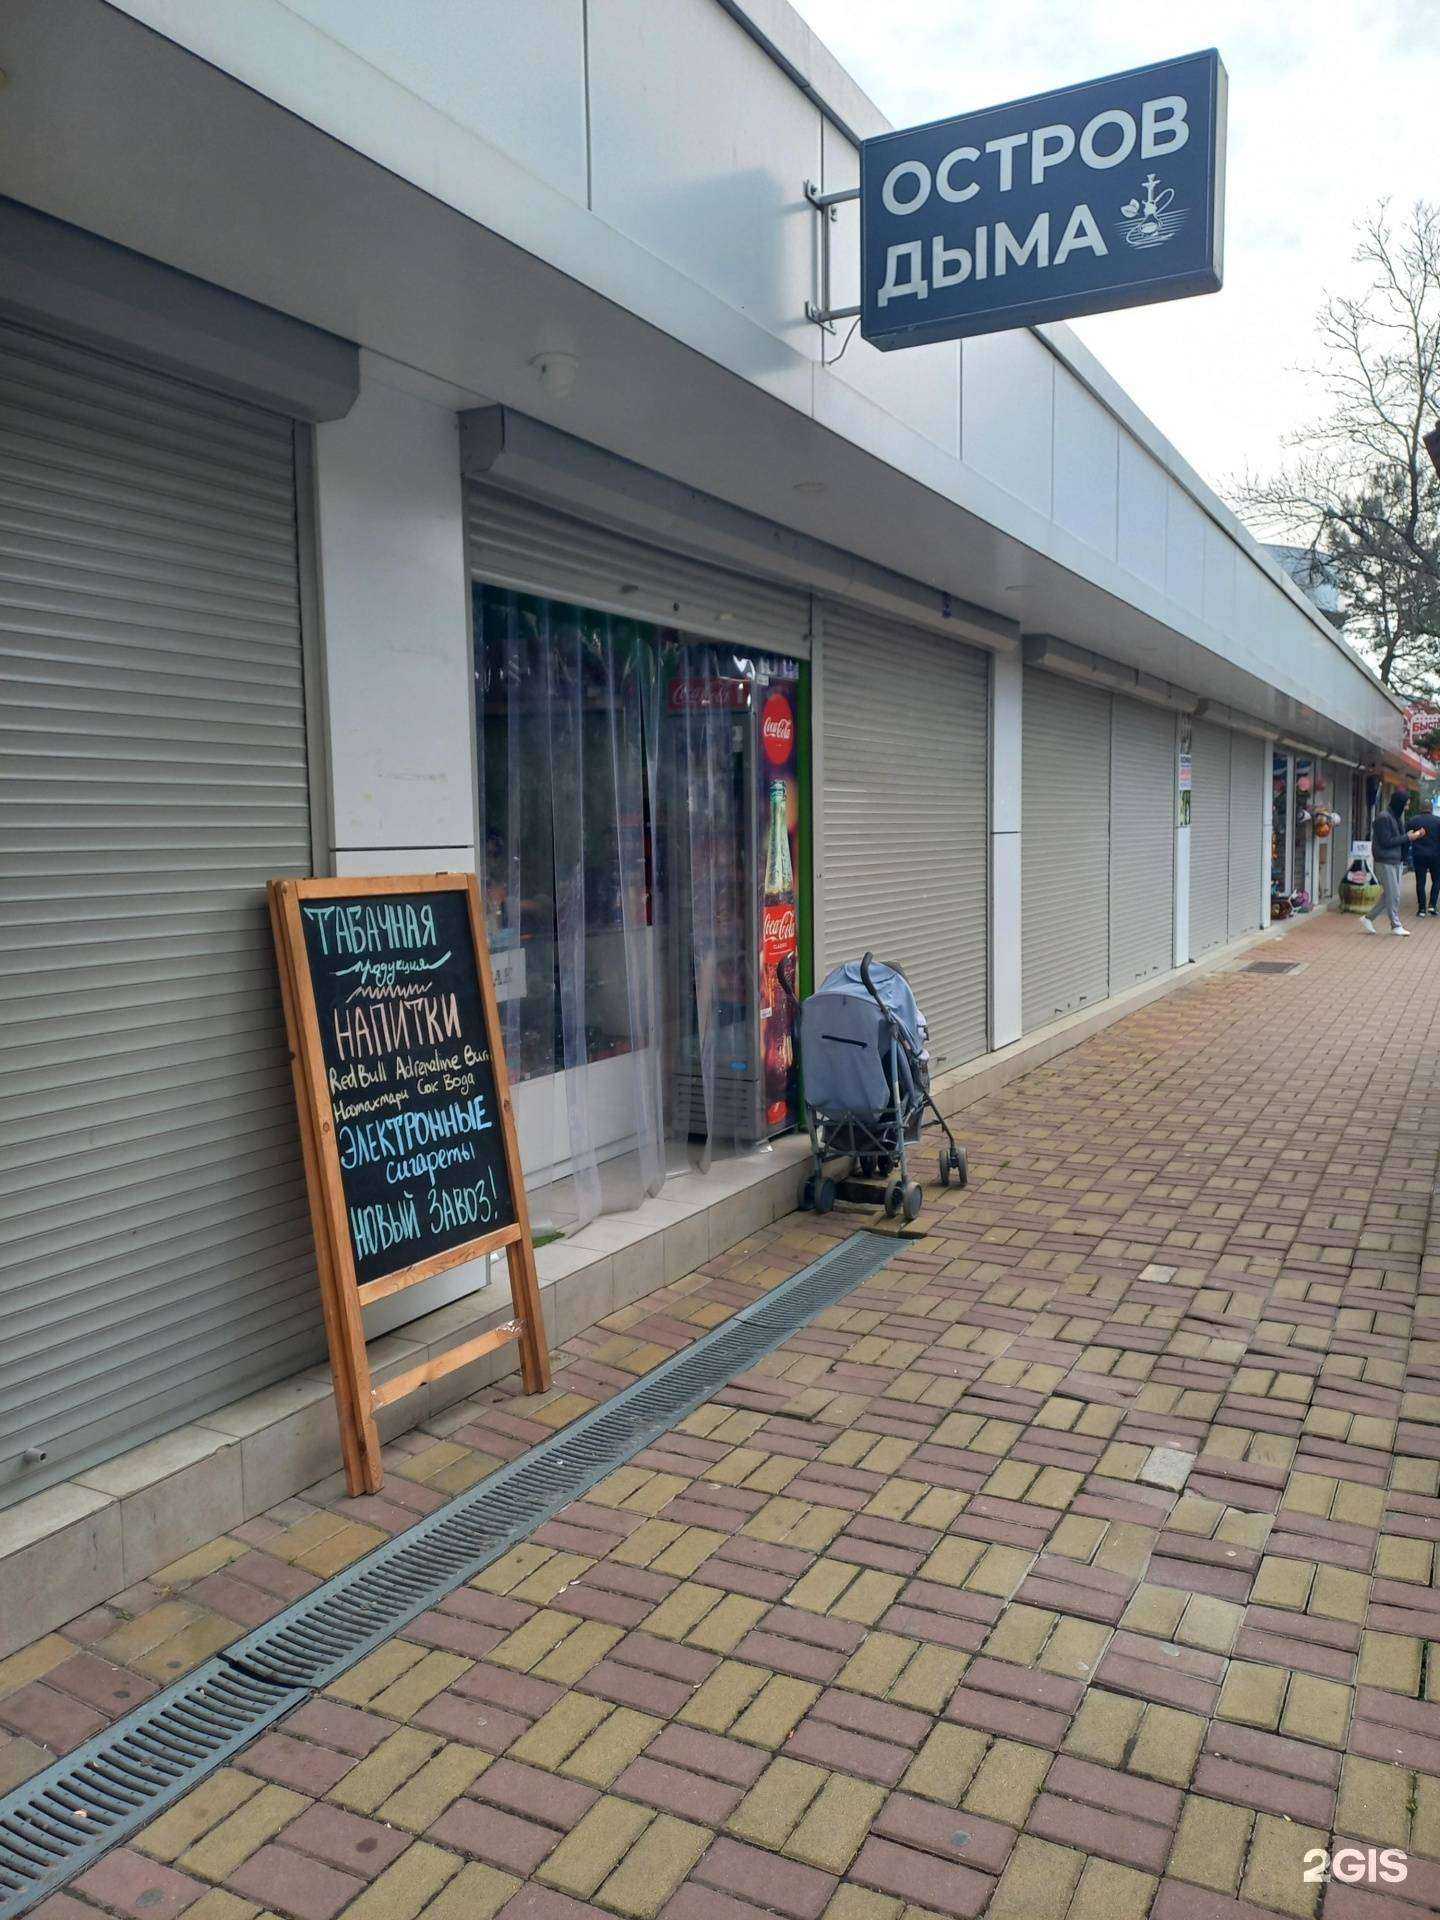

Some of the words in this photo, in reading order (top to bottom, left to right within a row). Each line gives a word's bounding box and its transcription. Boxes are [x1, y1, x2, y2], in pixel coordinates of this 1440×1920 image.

[882, 95, 1190, 215] ОСТРОВ
[877, 204, 1109, 307] ДЫМА
[303, 903, 437, 955] ТАБАЧНАЯ
[334, 993, 462, 1060] НАПИТКИ
[340, 1095, 492, 1169] ЭЛЕКТРОННЫЕ
[351, 1190, 421, 1260] НОВЫЙ
